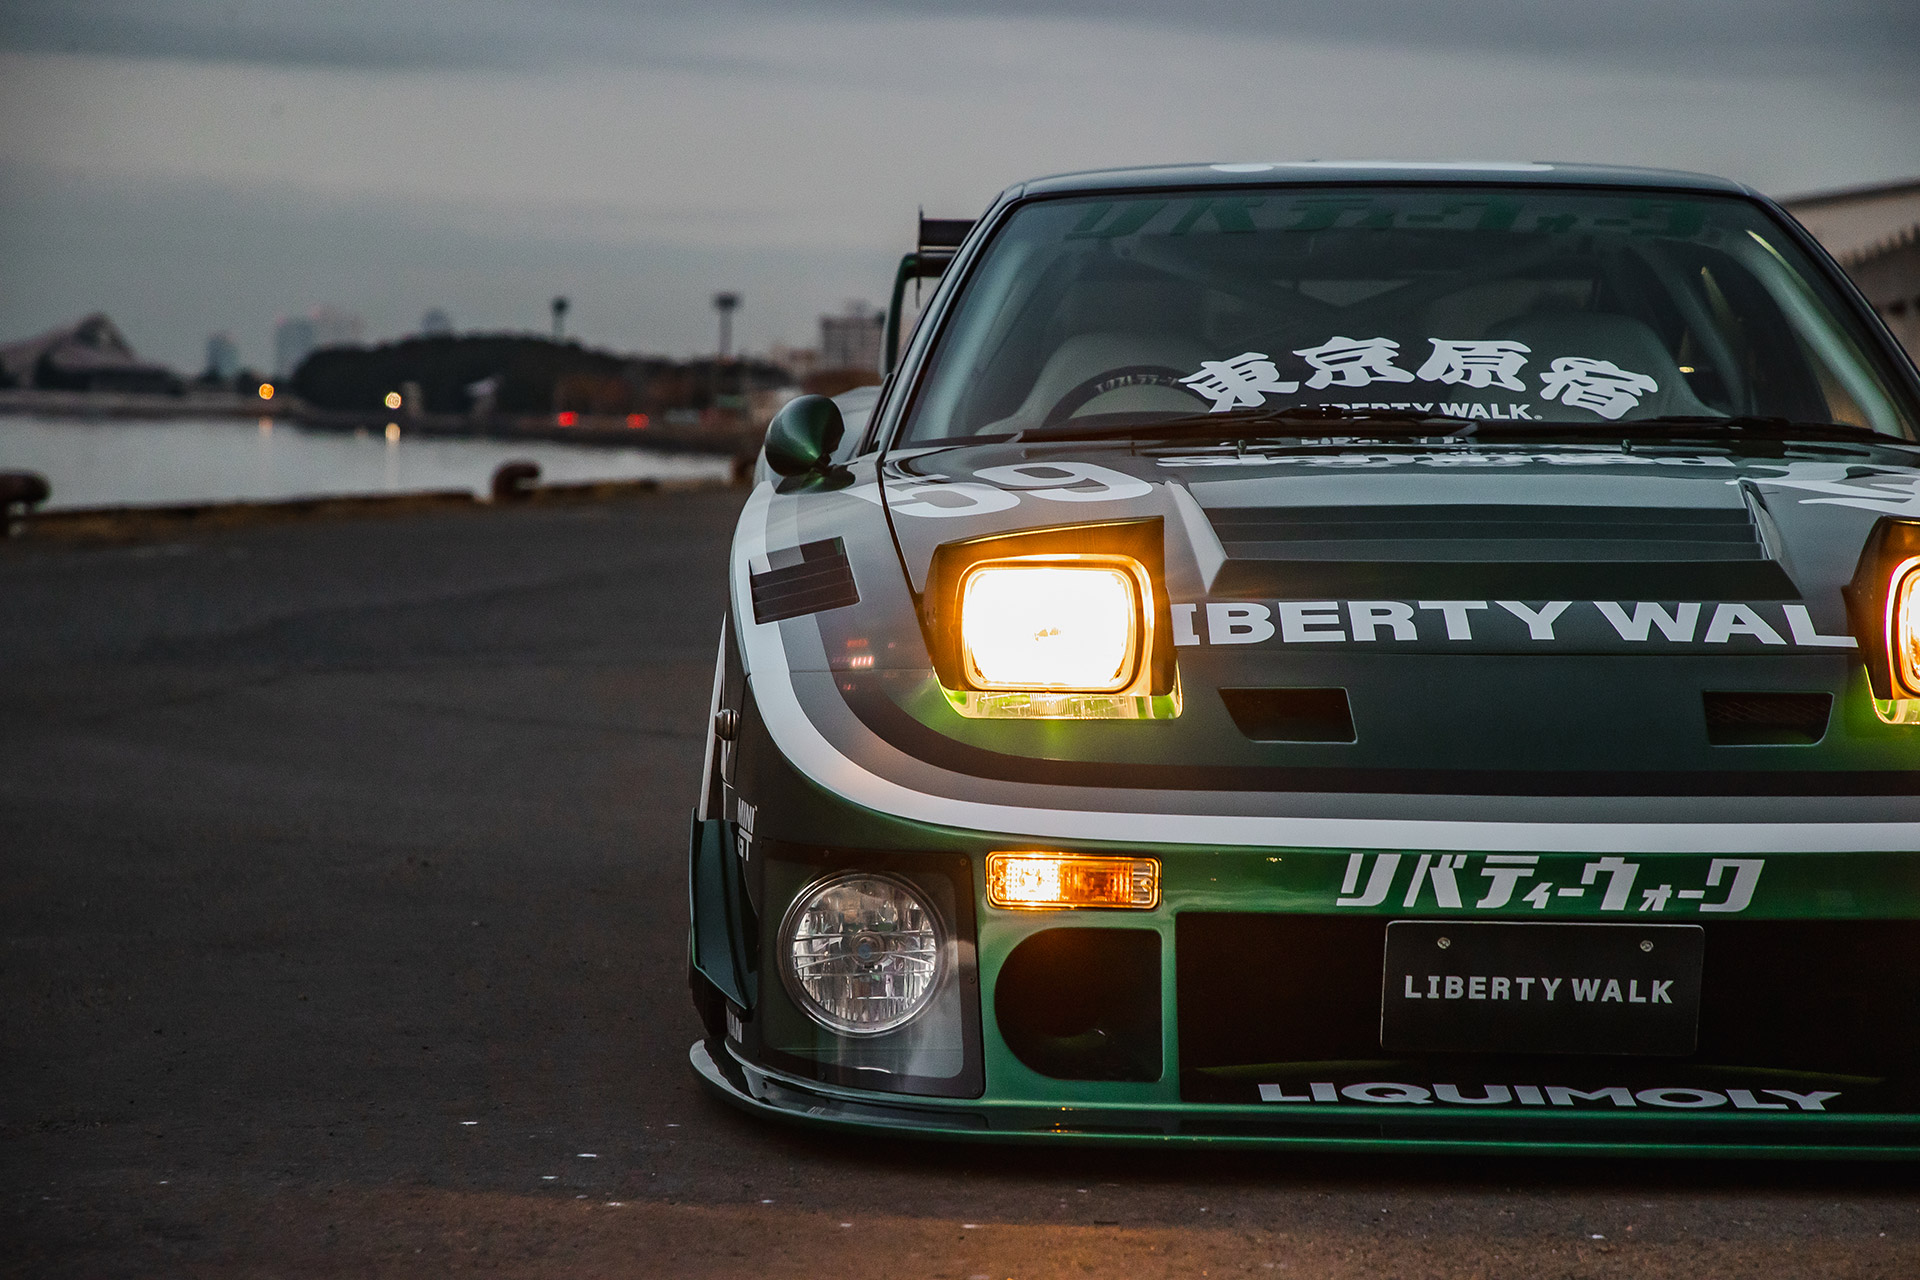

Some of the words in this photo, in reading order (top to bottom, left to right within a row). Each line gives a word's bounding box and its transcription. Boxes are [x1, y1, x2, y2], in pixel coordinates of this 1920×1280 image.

[1178, 336, 1659, 420] 東京原宿
[850, 461, 1153, 518] 59
[1170, 600, 1573, 646] IBERTY
[1592, 600, 1860, 648] WAL
[1336, 852, 1765, 913] リバティーウォーク
[1404, 974, 1563, 1002] LIBERTY
[1571, 977, 1675, 1005] WALK
